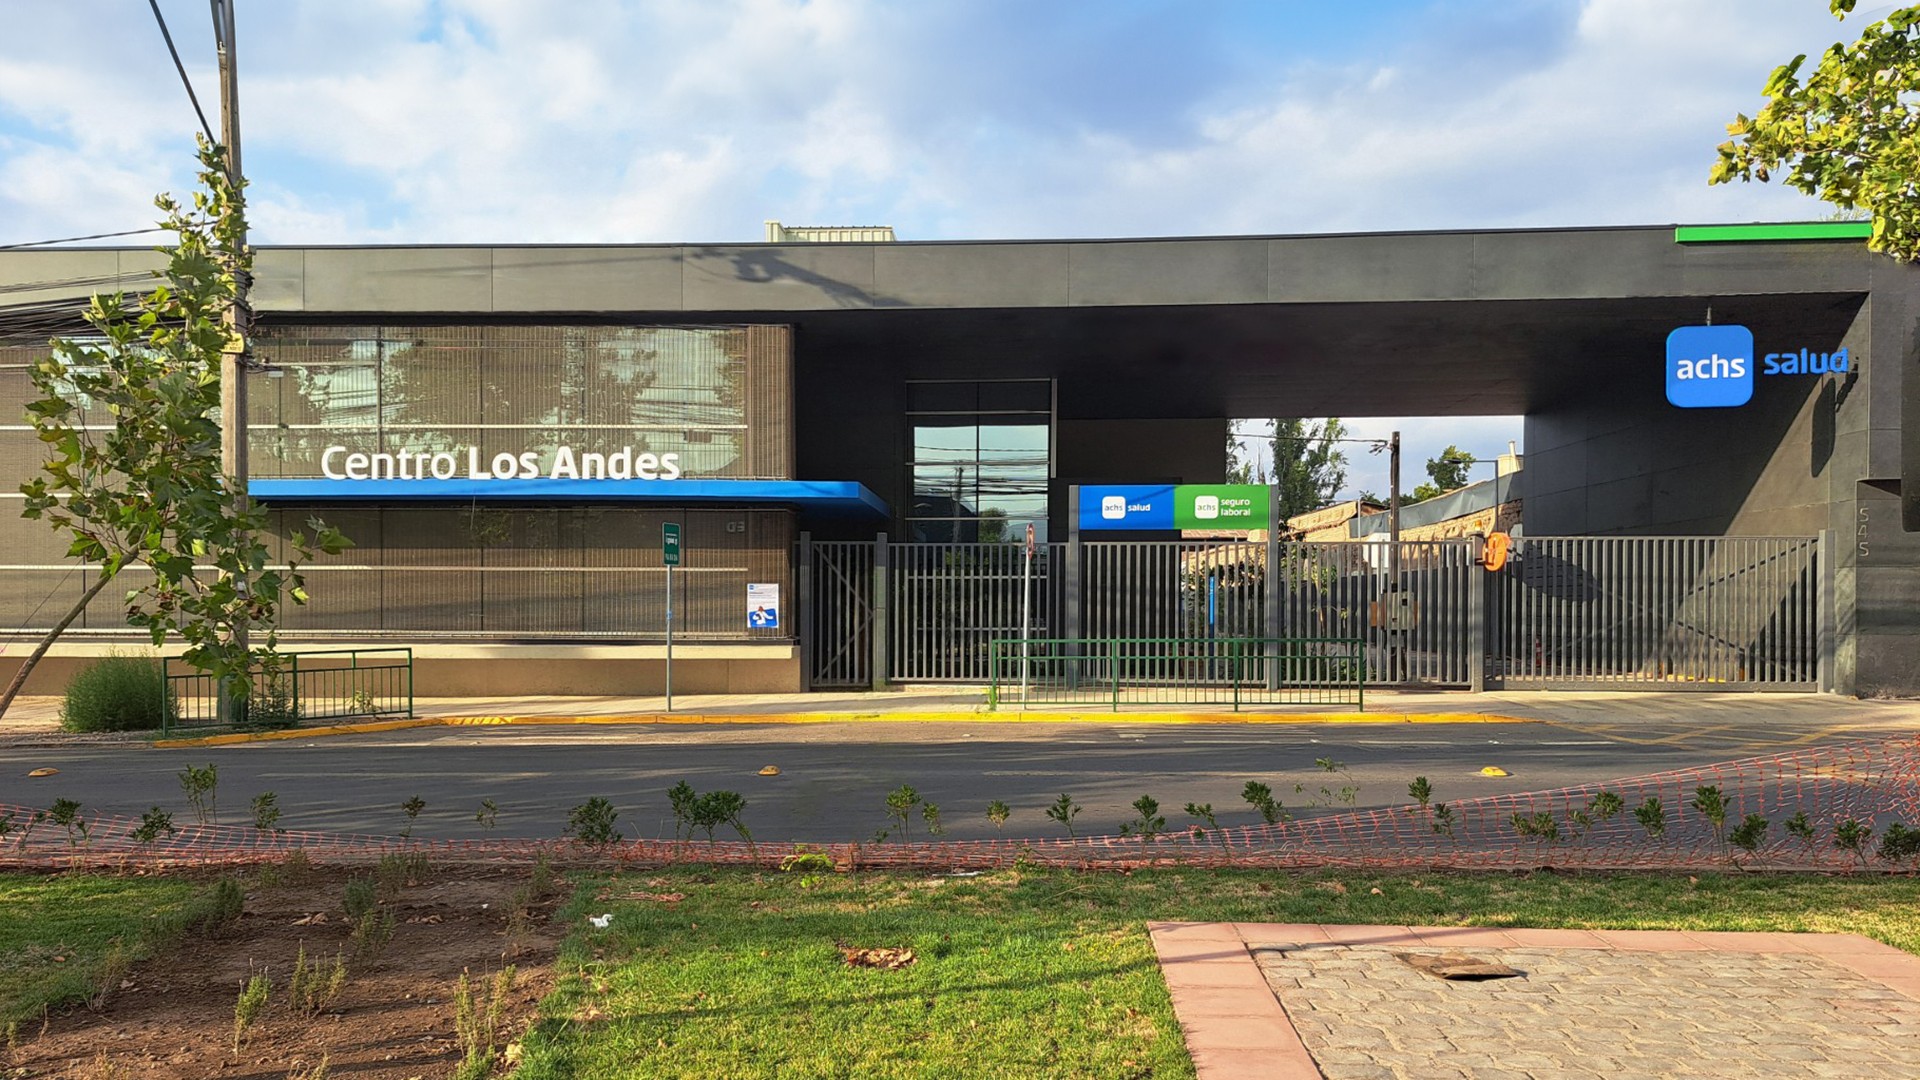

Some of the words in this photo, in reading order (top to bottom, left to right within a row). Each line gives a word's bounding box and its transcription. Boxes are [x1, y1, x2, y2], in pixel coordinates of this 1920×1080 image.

[1677, 353, 1745, 380] achs
[1763, 347, 1849, 375] salud
[321, 445, 457, 480] Centro
[468, 446, 539, 480] Los
[549, 445, 680, 480] Andes
[1104, 504, 1123, 512] achs
[1127, 503, 1151, 512] salud
[1197, 504, 1216, 512] achs
[1221, 498, 1250, 507] seguro
[1221, 508, 1251, 516] laboral
